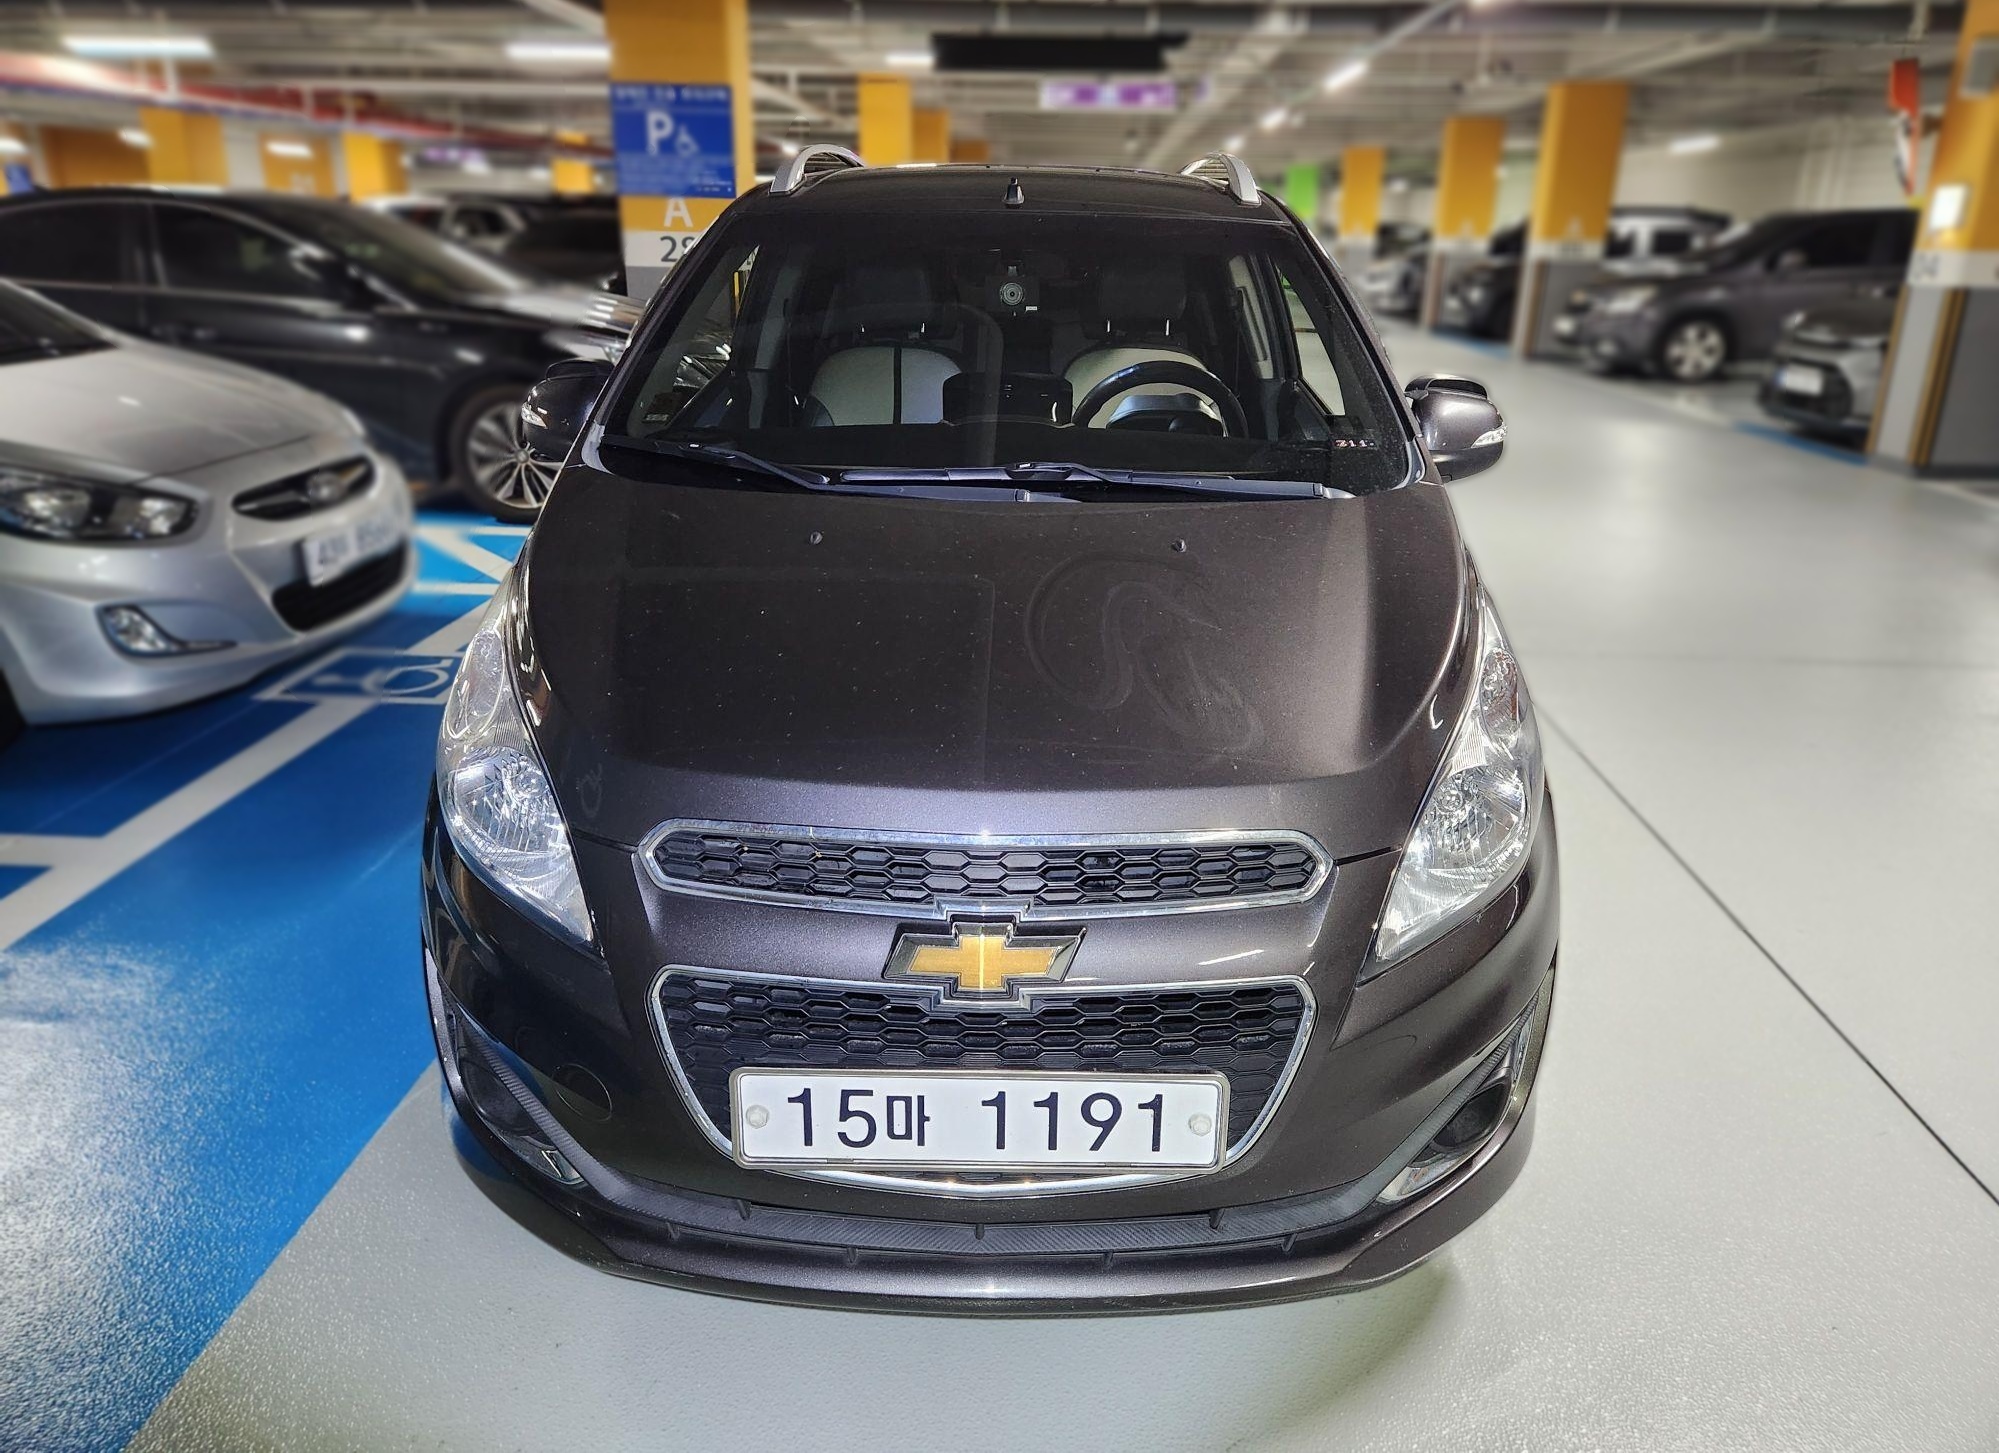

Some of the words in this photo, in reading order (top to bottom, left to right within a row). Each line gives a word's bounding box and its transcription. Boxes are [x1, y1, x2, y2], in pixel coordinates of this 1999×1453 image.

[646, 110, 674, 156] P
[663, 197, 694, 228] A
[787, 1087, 931, 1148] 15마
[980, 1090, 1164, 1152] 1191
